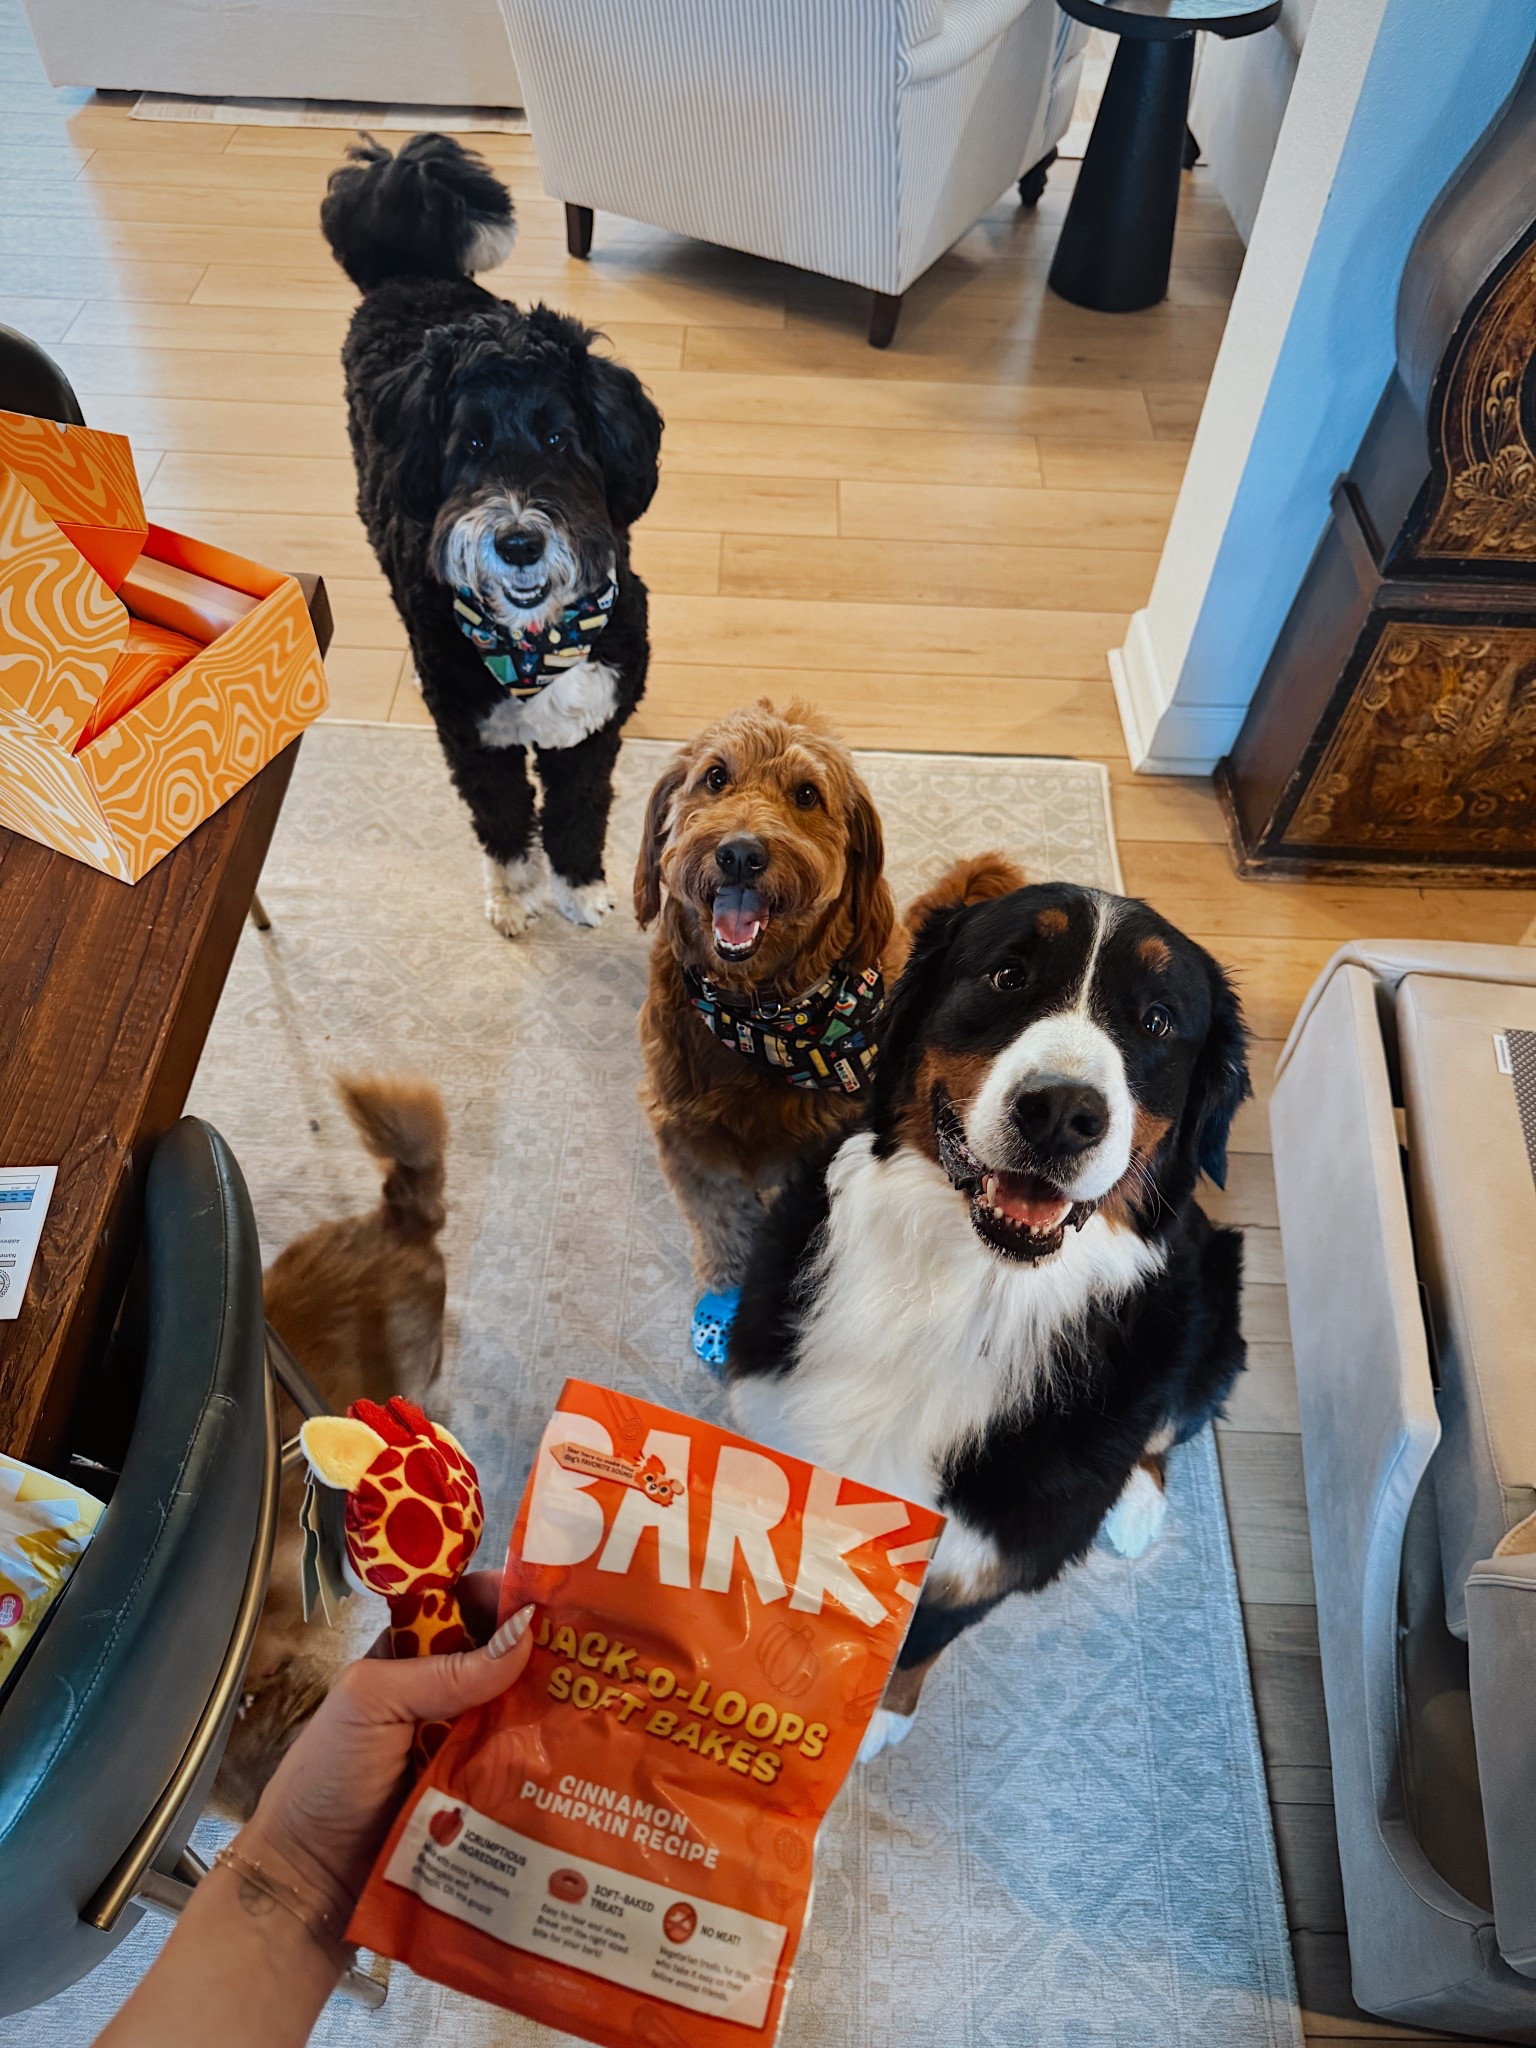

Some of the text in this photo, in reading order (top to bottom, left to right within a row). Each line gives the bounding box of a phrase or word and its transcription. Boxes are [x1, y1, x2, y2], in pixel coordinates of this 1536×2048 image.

[580, 1457, 610, 1472] FAVORITE
[610, 1467, 633, 1479] SOUND
[522, 1411, 910, 1628] BARK
[532, 1616, 829, 1758] JACK-O-LOOPS
[548, 1666, 783, 1783] SOFT BAKES
[520, 1781, 720, 1870] PUMPKIN RECIPE
[558, 1775, 690, 1836] CINNAMON
[458, 1842, 517, 1877] INGREDIENTS
[590, 1897, 624, 1917] TREATS
[594, 1884, 654, 1912] SOFT-BAKED
[701, 1925, 741, 1945] NO MEAT!
